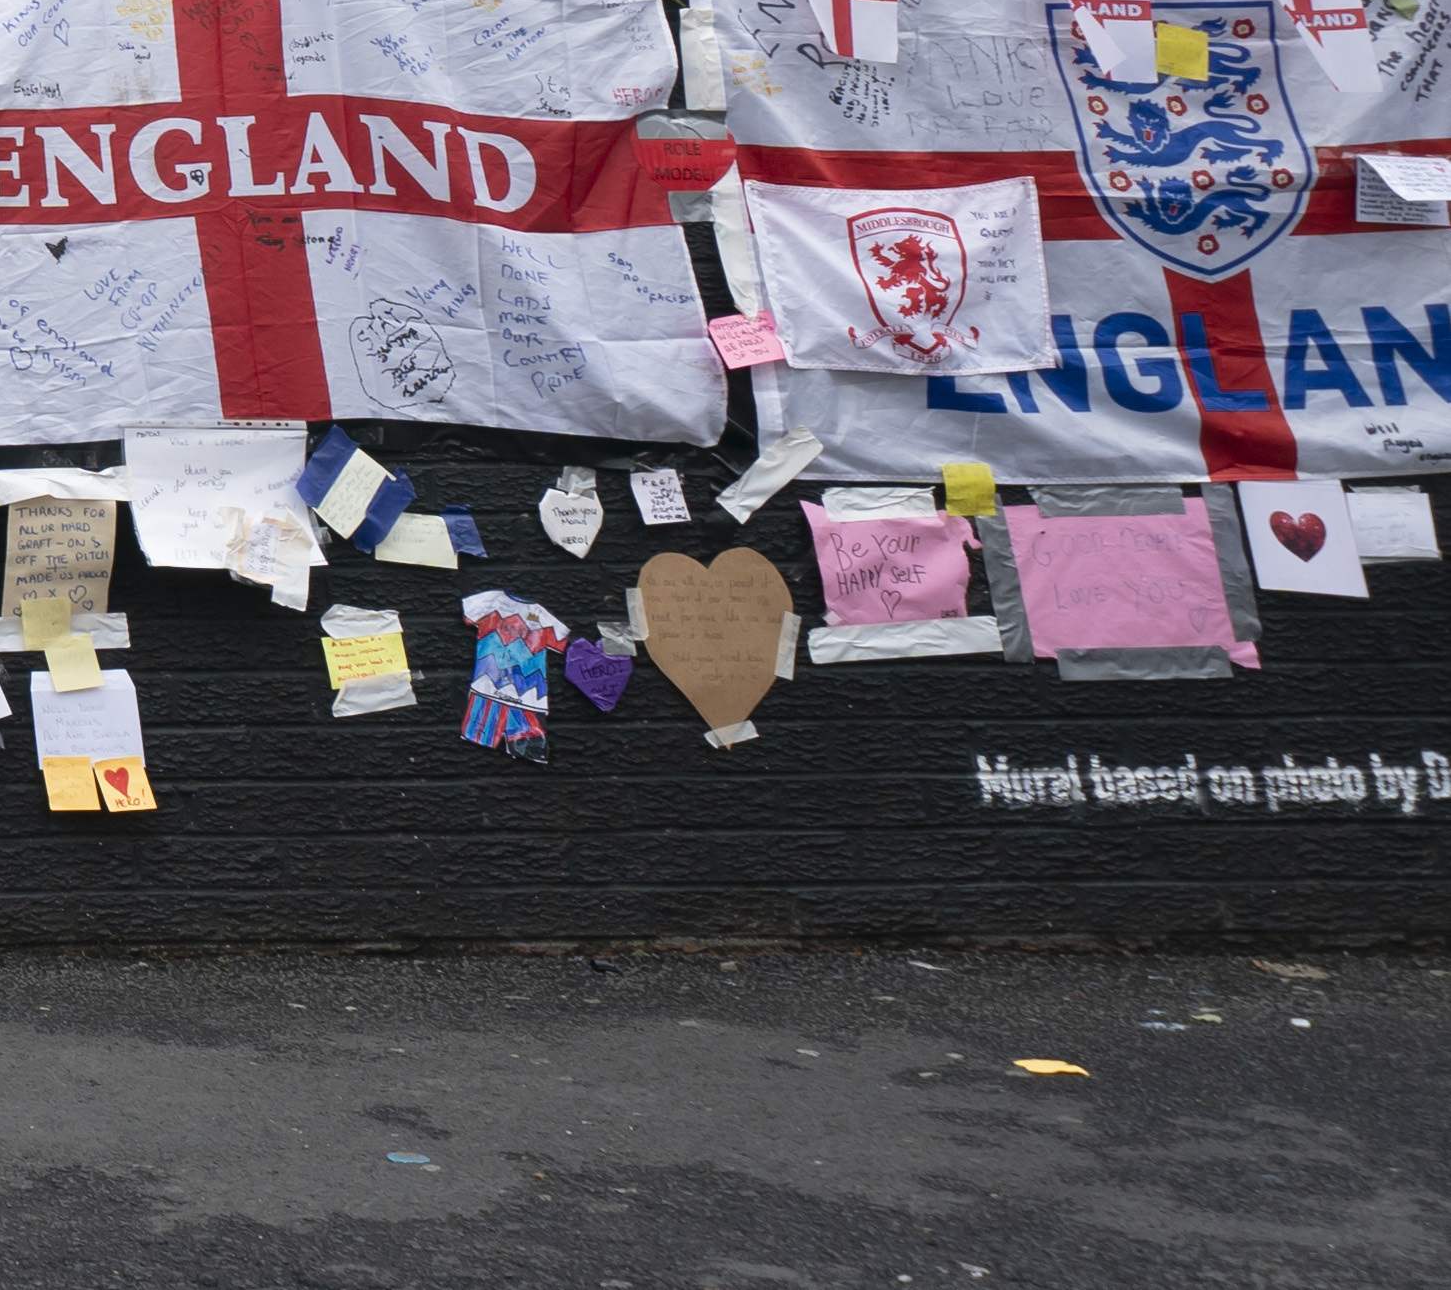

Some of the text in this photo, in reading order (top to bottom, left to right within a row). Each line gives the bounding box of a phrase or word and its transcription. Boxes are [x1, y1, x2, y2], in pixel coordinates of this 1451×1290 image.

[664, 141, 702, 156] ROLE
[855, 216, 950, 235] MIDDLESBROUGH
[501, 264, 549, 285] DONE
[504, 344, 585, 367] COUNTRY
[909, 351, 942, 364] 1876
[15, 506, 106, 519] THANKS FOR
[73, 550, 112, 562] PITCH
[829, 532, 869, 573] Be
[839, 569, 883, 596] HAPPY
[579, 656, 624, 680] HERO!
[976, 754, 1086, 806] Mural
[1090, 754, 1199, 803] based
[1211, 767, 1257, 804] on
[1263, 754, 1367, 813] photo
[1370, 754, 1416, 815] by
